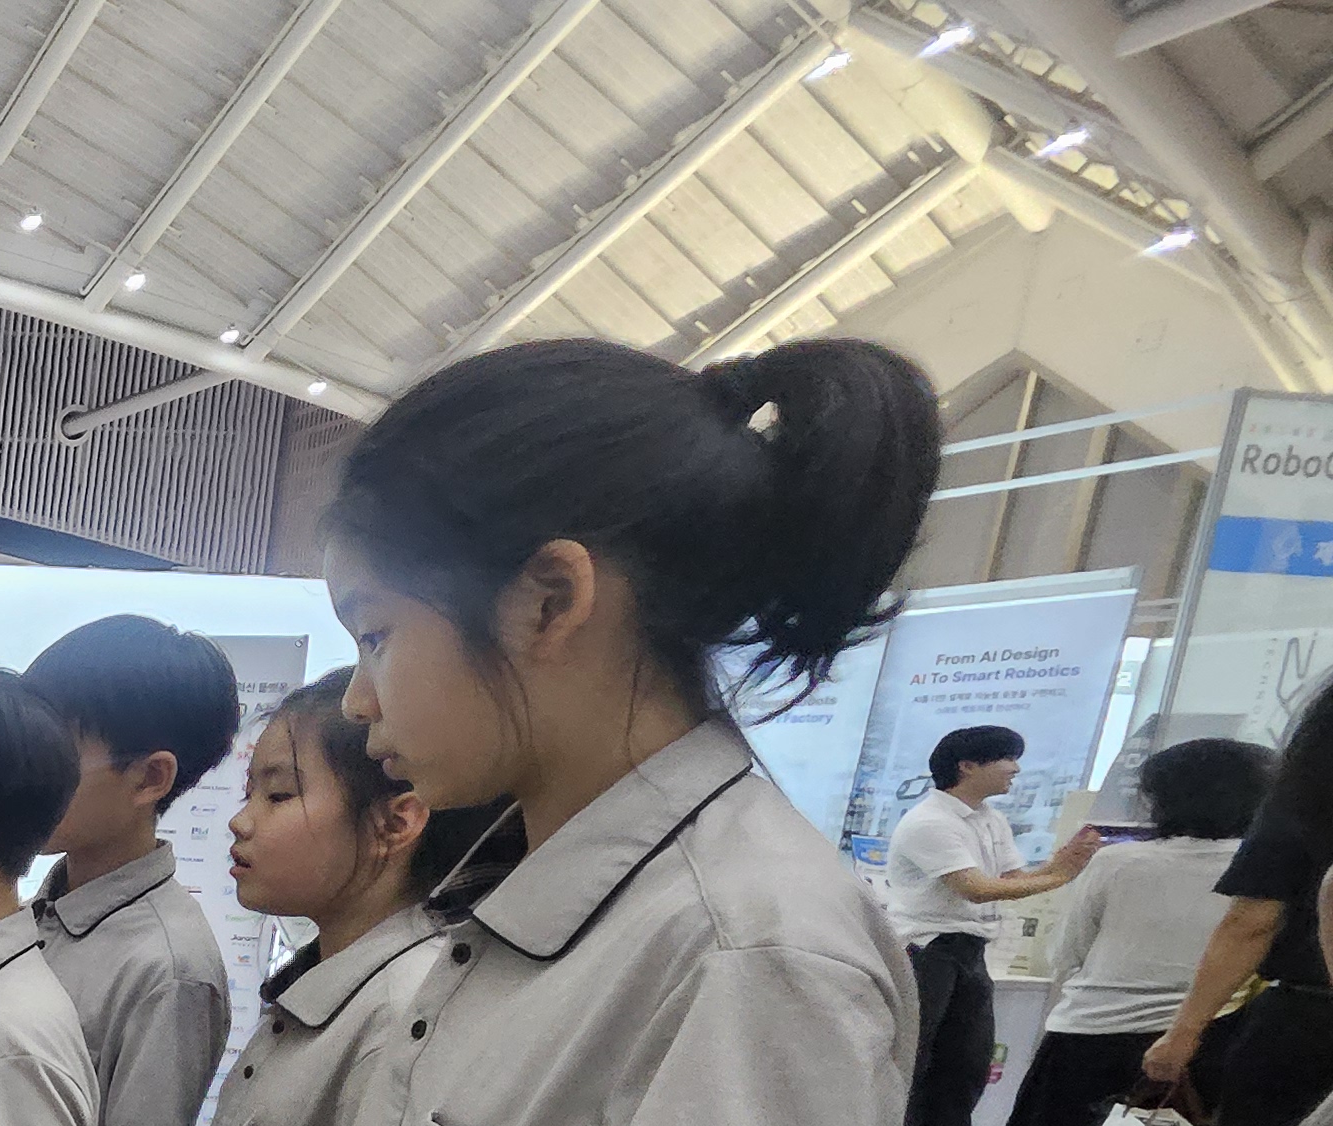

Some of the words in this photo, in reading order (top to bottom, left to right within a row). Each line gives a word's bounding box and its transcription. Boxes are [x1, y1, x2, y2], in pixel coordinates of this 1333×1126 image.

[935, 652, 976, 666] From
[979, 651, 998, 663] AI
[1000, 646, 1061, 663] Design
[909, 674, 928, 686] AI
[931, 672, 949, 684] To
[952, 670, 1001, 683] Smart
[1004, 664, 1081, 681] Robotics
